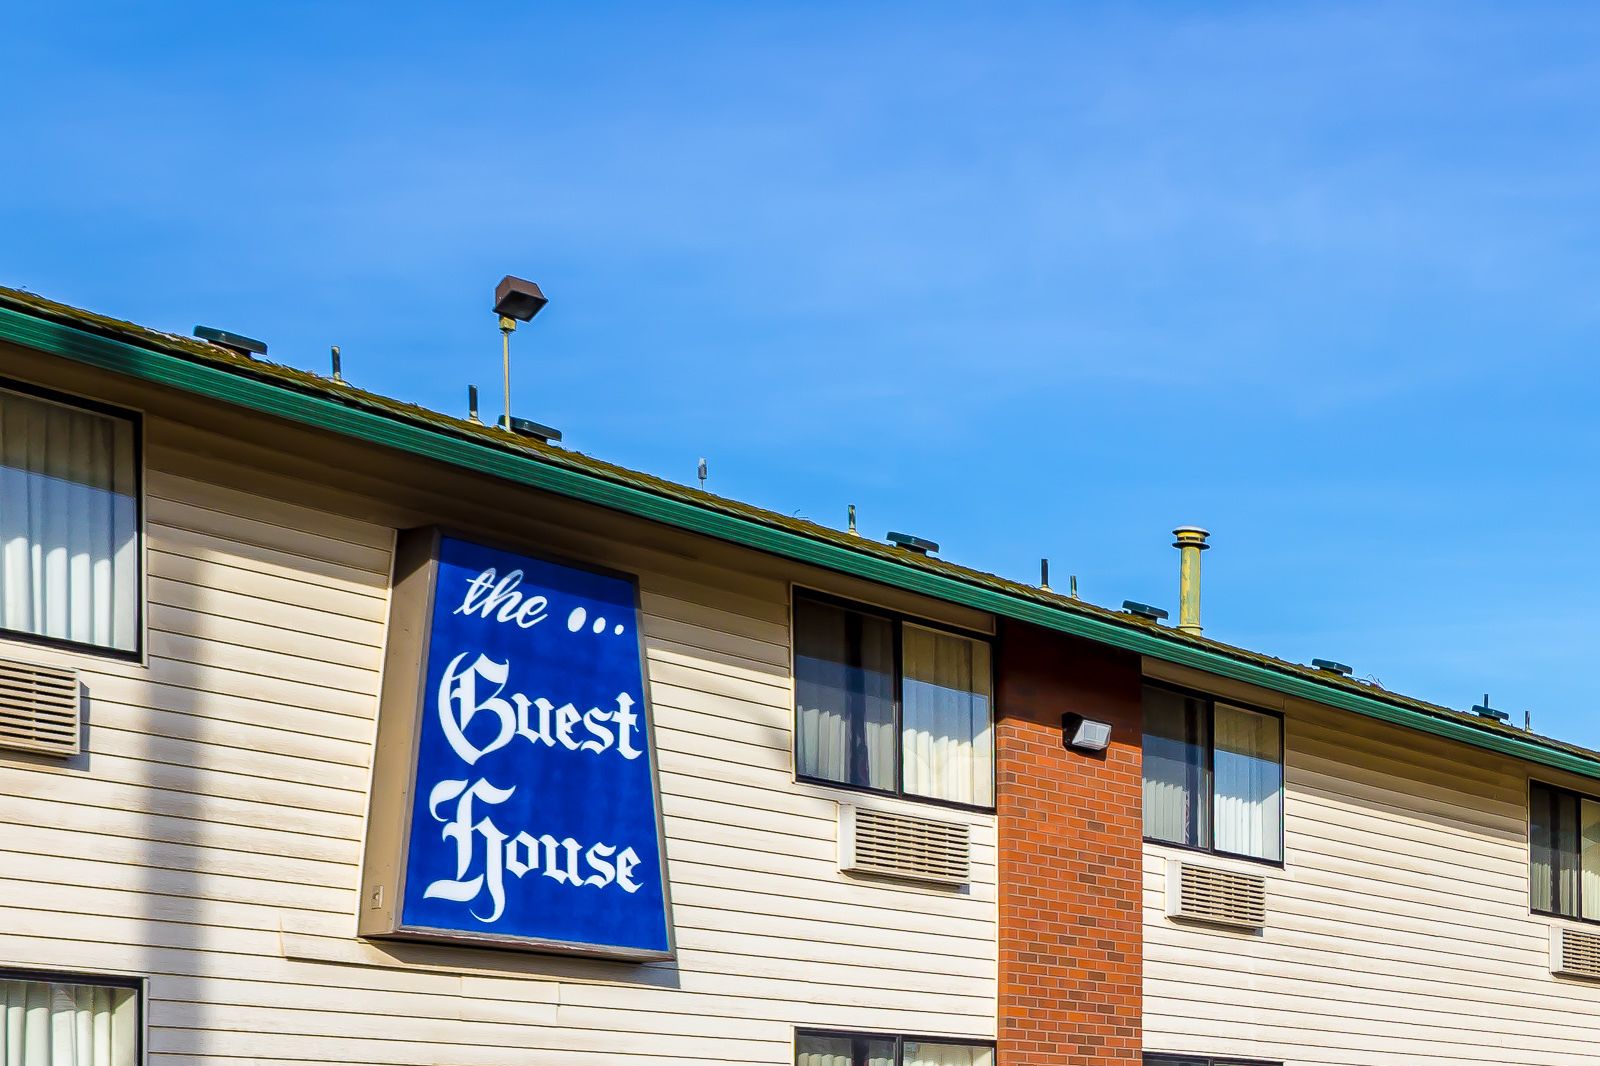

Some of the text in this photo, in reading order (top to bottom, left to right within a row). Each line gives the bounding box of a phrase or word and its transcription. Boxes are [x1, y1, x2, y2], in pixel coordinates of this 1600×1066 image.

[453, 567, 547, 629] the
[437, 651, 643, 766] Guest
[423, 777, 644, 923] House
